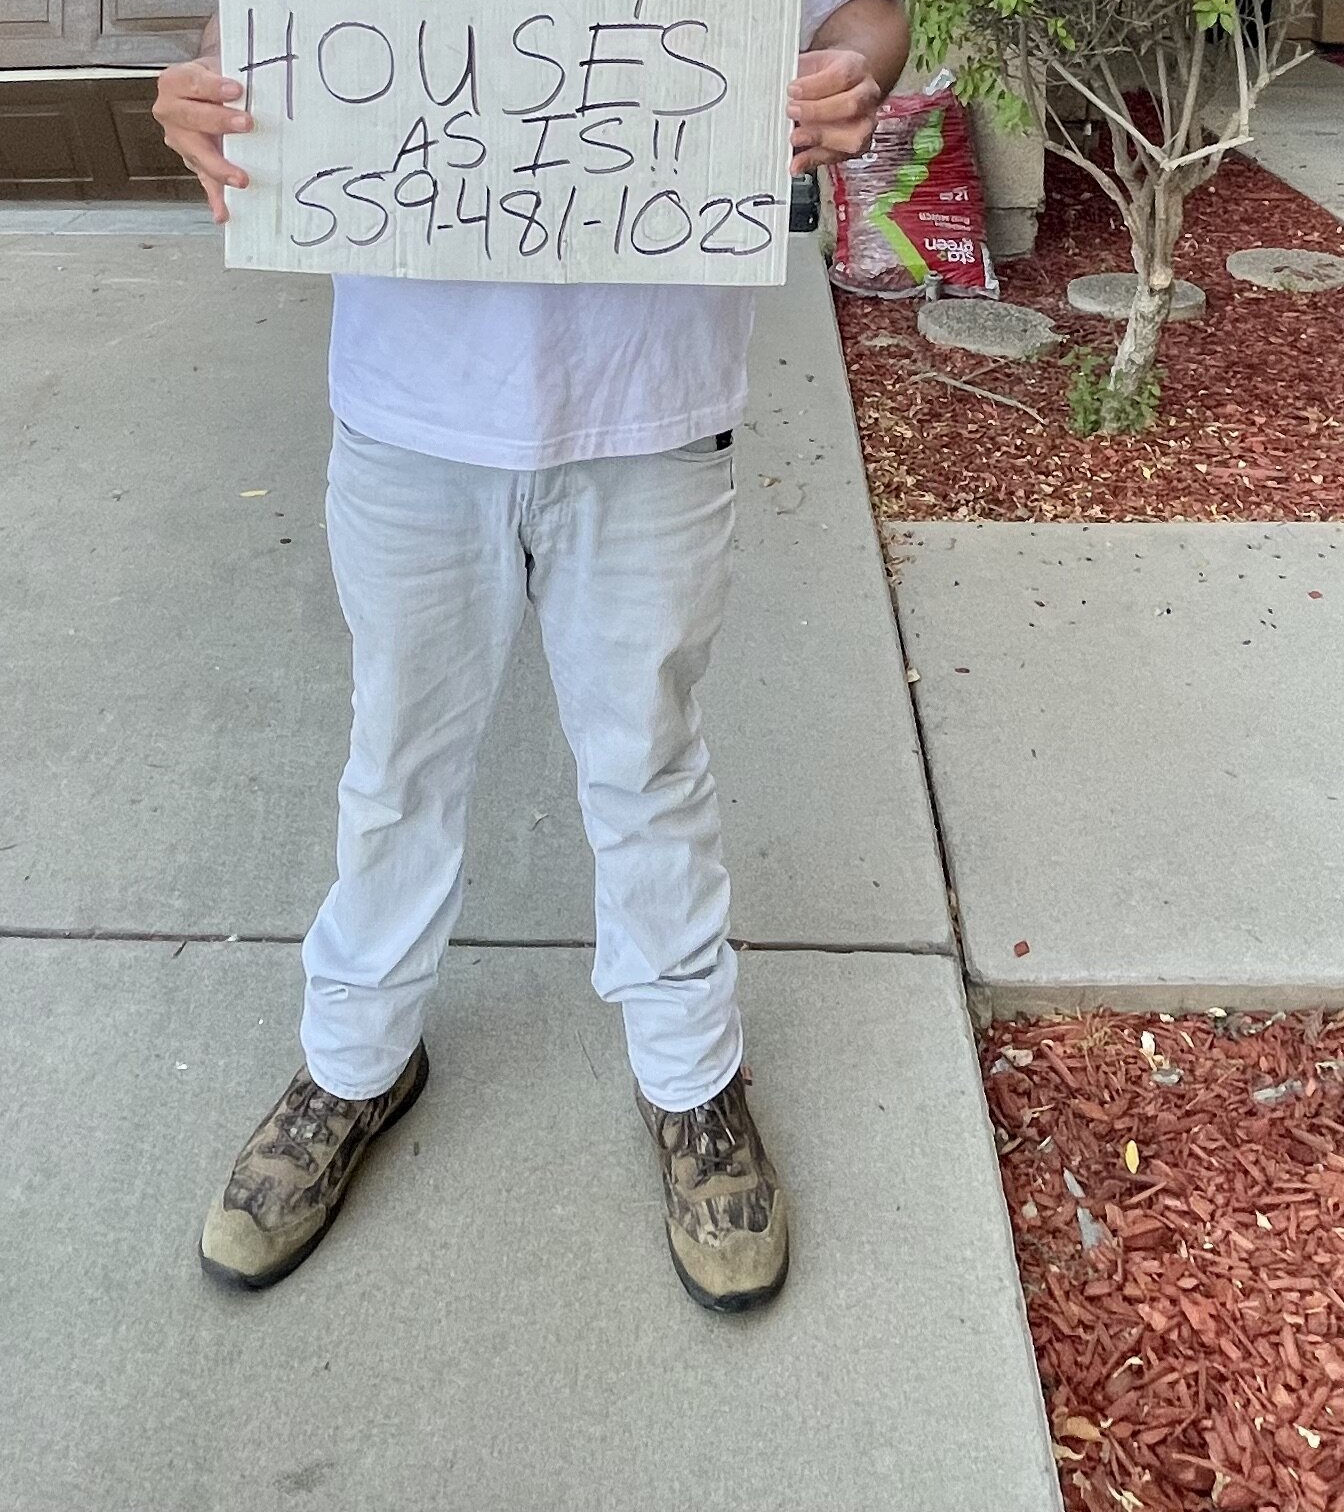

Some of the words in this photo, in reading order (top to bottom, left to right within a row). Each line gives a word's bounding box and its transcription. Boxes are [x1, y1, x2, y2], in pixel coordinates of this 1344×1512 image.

[239, 8, 728, 121] HOUSES
[392, 111, 488, 174] AS
[513, 112, 687, 176] IS!!
